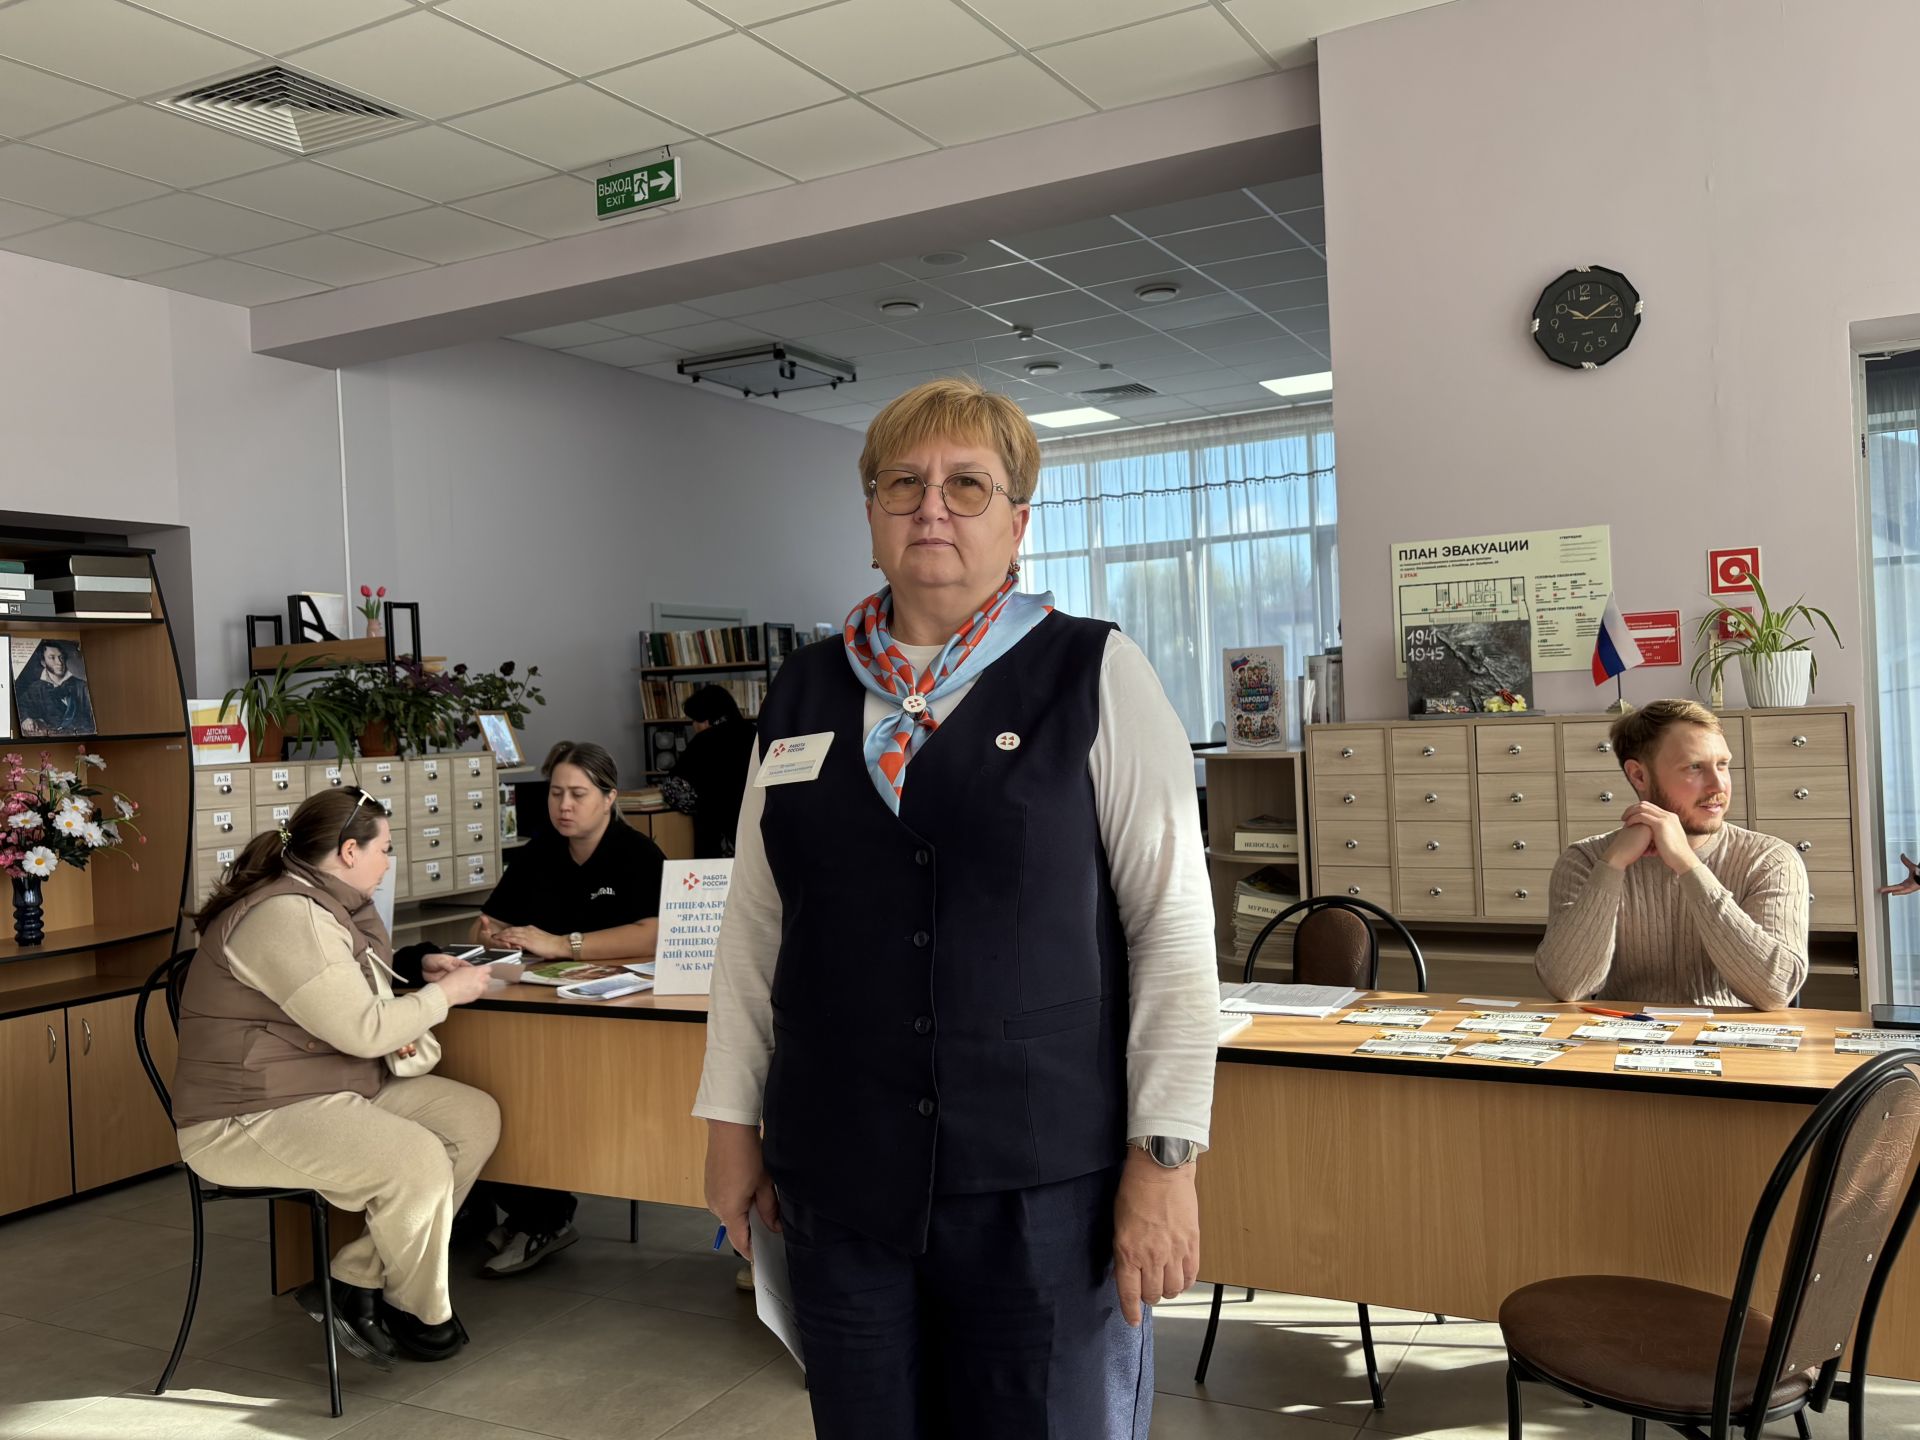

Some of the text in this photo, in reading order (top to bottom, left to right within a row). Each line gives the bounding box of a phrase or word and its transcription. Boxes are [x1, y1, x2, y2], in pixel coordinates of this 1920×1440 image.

[598, 177, 632, 197] ВЫХОД
[606, 194, 626, 207] EXIT
[1567, 289, 1576, 300] 11
[1579, 283, 1591, 295] 12
[1555, 303, 1568, 314] 10
[1399, 539, 1529, 561] ПЛАН ЭВАКУАЦИИ
[1407, 629, 1437, 645] 1941
[1408, 646, 1445, 661] 1945
[1248, 904, 1281, 915] МУРЗИЛК
[670, 925, 711, 934] ФИЛИАЛ
[663, 949, 682, 959] КИЙ
